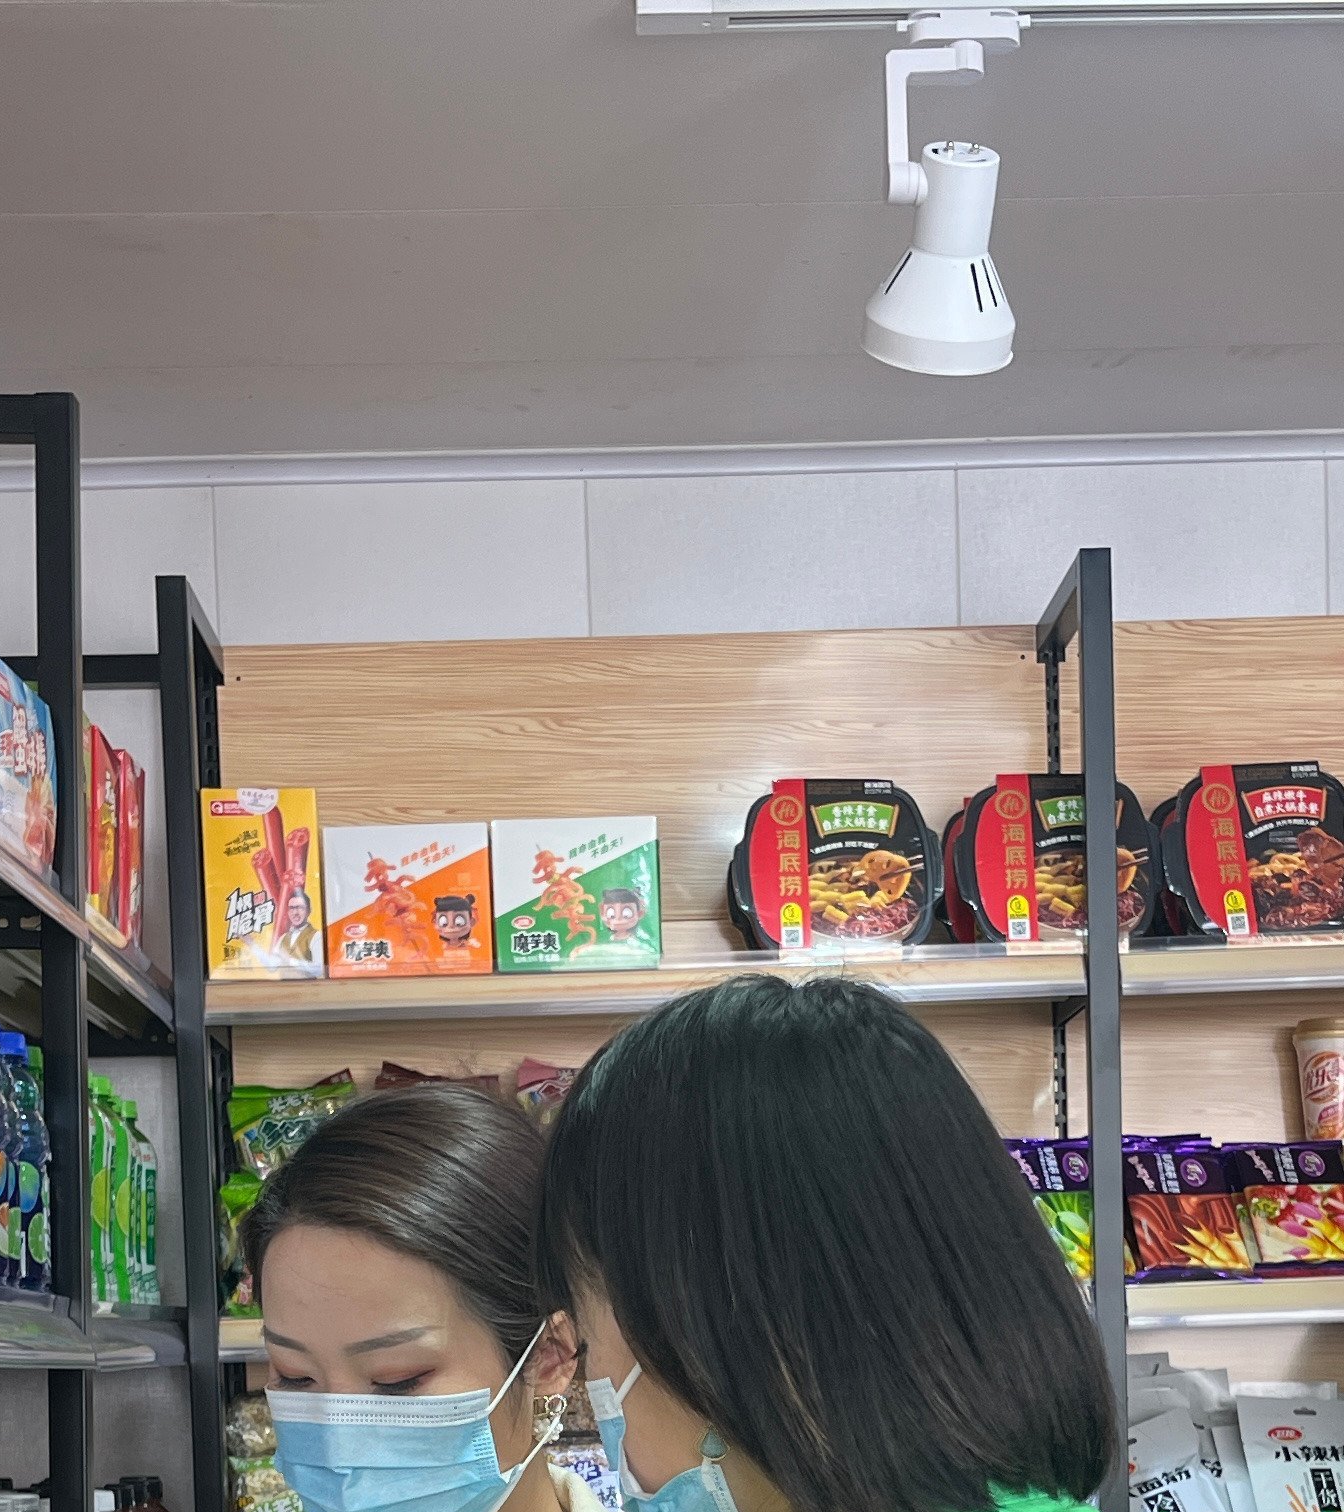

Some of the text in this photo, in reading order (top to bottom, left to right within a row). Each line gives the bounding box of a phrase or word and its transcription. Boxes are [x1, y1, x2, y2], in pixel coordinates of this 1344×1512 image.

[775, 829, 803, 898] 海底捞
[1000, 822, 1029, 890] 海底捞
[1210, 817, 1244, 885] 海底捞
[344, 940, 392, 962] 魔芋爽
[512, 931, 561, 954] 魔芋爽
